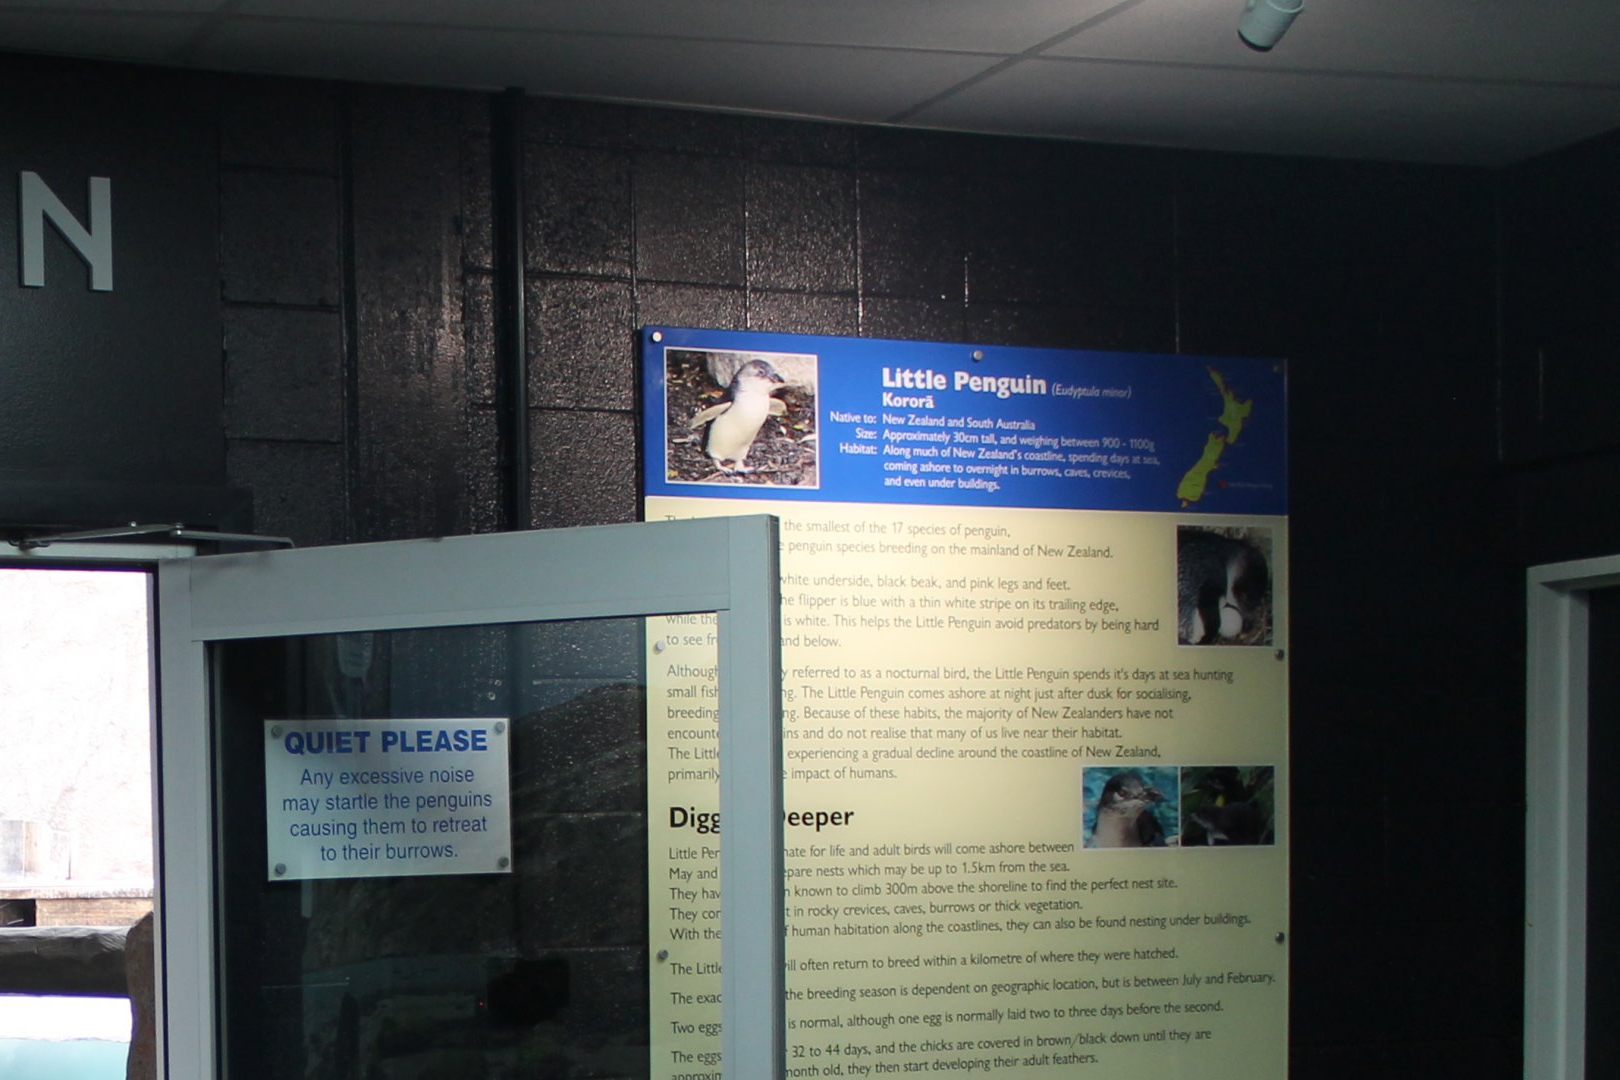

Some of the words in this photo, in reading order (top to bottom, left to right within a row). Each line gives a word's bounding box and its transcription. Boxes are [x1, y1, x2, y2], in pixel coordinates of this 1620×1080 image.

[882, 368, 948, 391] Little
[954, 371, 1047, 398] Penguin
[831, 411, 862, 424] Native
[864, 414, 878, 424] to:
[883, 413, 906, 425] New
[908, 413, 946, 427] Zealand
[948, 417, 965, 428] and
[967, 416, 995, 429] South
[997, 418, 1036, 431] Australia
[856, 427, 878, 440] Size:
[883, 428, 952, 446] Approximately
[954, 431, 980, 444] 30cm
[981, 433, 999, 446] tall,
[1000, 434, 1018, 445] and
[1020, 435, 1060, 450] weighing
[1061, 436, 1100, 448] between
[1103, 437, 1121, 449] 900
[1131, 438, 1156, 453] 1100g
[840, 442, 878, 455] Habitat:
[884, 444, 912, 460] Along
[913, 446, 939, 458] much
[941, 446, 953, 458] of
[953, 446, 977, 459] New
[978, 447, 1023, 461] Zealand's
[1024, 451, 1067, 463] coastline,
[1069, 452, 1109, 466] spending
[1110, 453, 1130, 466] days
[885, 461, 919, 476] coming
[920, 461, 952, 473] ashore
[953, 464, 965, 474] to
[966, 464, 1009, 478] overnight
[1011, 465, 1020, 475] in
[1022, 465, 1062, 478] burrows,
[1064, 469, 1091, 478] caves,
[1093, 470, 1131, 479] crevices,
[885, 475, 903, 487] and
[904, 478, 927, 488] even
[928, 477, 957, 489] under
[958, 477, 1001, 493] buildings.
[784, 518, 803, 532] the
[807, 519, 851, 533] smallest
[854, 520, 867, 534] of
[870, 521, 887, 534] the
[893, 521, 904, 534] 17
[908, 524, 947, 539] species
[950, 523, 963, 536] of
[965, 524, 1012, 541] penguin,
[814, 574, 874, 589] underside,
[878, 574, 907, 588] black
[912, 575, 942, 590] beak,
[946, 576, 967, 590] and
[970, 576, 995, 593] pink
[998, 576, 1020, 595] legs
[1022, 577, 1043, 591] and
[1047, 577, 1072, 592] feet.
[284, 731, 370, 755] QUIET
[381, 729, 488, 753] PLEASE
[300, 769, 334, 789] Any
[339, 768, 424, 785] excessive
[429, 766, 475, 783] noise
[668, 768, 721, 784] primarily
[791, 767, 832, 782] impact
[834, 766, 848, 778] of
[850, 766, 898, 779] humans.
[282, 798, 319, 814] may
[325, 794, 378, 811] startle
[383, 793, 410, 809] the
[416, 791, 492, 812] penguins
[290, 820, 357, 839] causing
[363, 818, 406, 834] them
[412, 819, 427, 833] to
[432, 816, 488, 833] retreat
[670, 806, 721, 835] Digg
[785, 810, 855, 833] eeper
[321, 847, 337, 861] to
[342, 845, 381, 860] their
[386, 843, 458, 860] burrows.
[669, 887, 699, 904] They
[702, 888, 722, 901] hav
[795, 885, 833, 898] known
[837, 885, 849, 897] to
[852, 883, 883, 897] climb
[886, 881, 919, 896] 300m
[922, 882, 955, 895] above
[957, 881, 976, 894] the
[978, 880, 1028, 894] shoreline
[1031, 881, 1044, 892] to
[1046, 878, 1067, 892] find
[1071, 878, 1089, 891] the
[1091, 877, 1130, 895] perfect
[1132, 879, 1155, 890] nest
[1157, 878, 1179, 889] site.
[669, 991, 694, 1006] The
[697, 993, 722, 1005] exac
[785, 987, 804, 1001] the
[807, 986, 857, 1004] breeding
[860, 987, 897, 999] season
[901, 985, 909, 997] is
[912, 982, 971, 1000] dependent
[974, 984, 989, 994] on
[992, 979, 1051, 997] geographic
[1053, 977, 1100, 991] location,
[1102, 976, 1120, 989] but
[1124, 976, 1132, 989] is
[1134, 975, 1180, 988] between
[1183, 973, 1203, 989] July
[1205, 972, 1225, 985] and
[1228, 971, 1277, 986] February.
